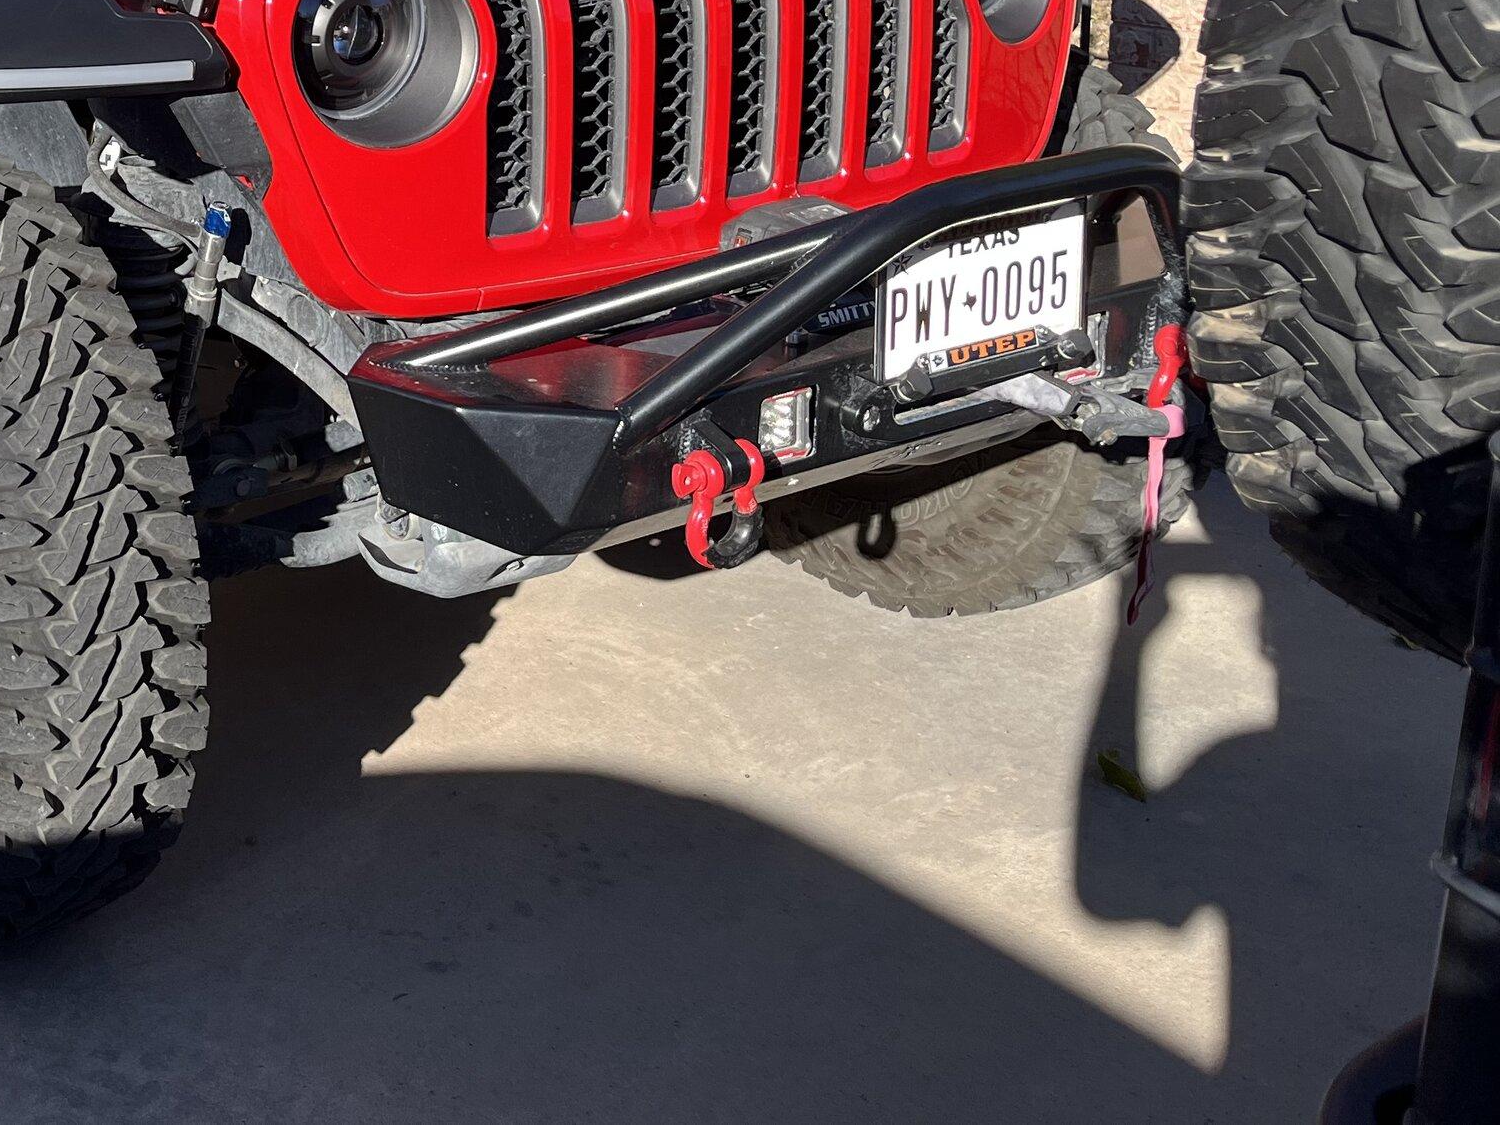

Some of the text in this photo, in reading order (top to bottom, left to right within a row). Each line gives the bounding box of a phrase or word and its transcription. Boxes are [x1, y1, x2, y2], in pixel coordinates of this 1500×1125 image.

[947, 227, 1021, 259] TEXAS
[890, 248, 1070, 352] PWY 0095
[949, 328, 1037, 365] UTEP
